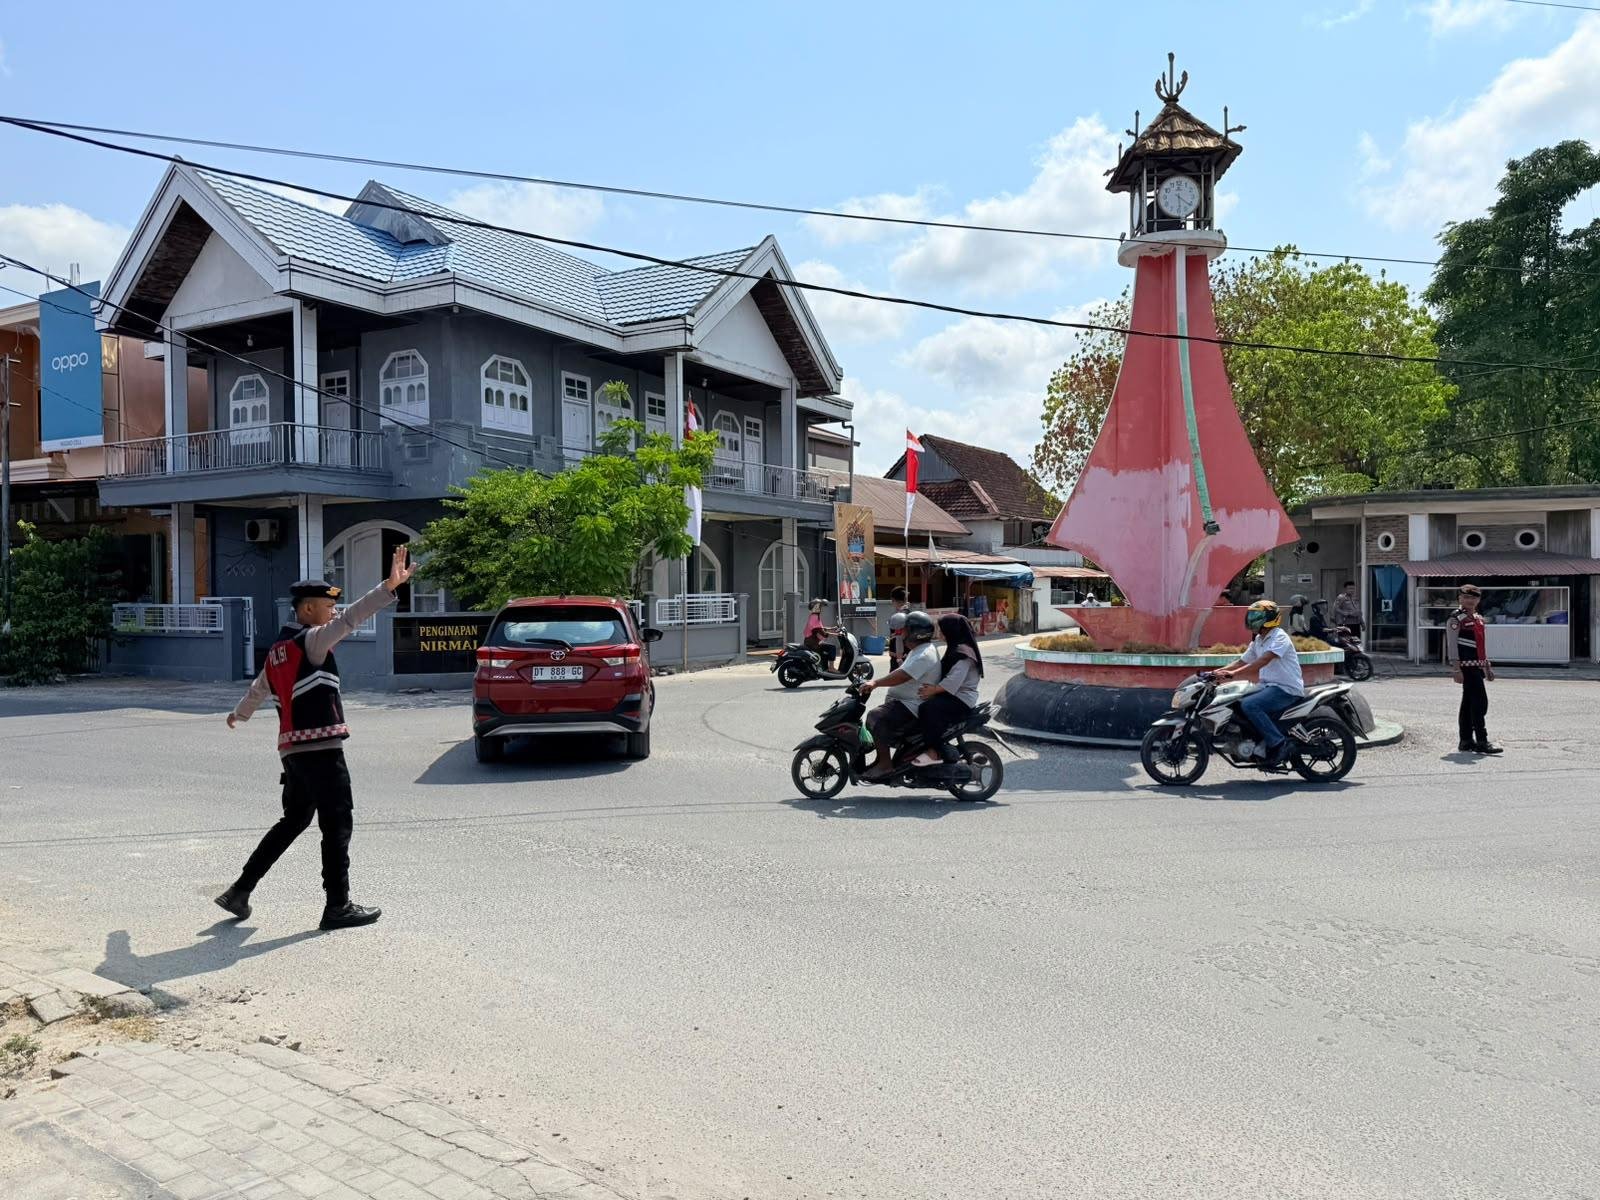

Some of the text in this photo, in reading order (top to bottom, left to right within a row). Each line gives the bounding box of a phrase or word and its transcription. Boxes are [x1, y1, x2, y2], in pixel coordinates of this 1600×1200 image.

[52, 352, 88, 373] oppo
[419, 625, 478, 637] PENGINAPAN
[534, 666, 582, 677] DT 888 GC
